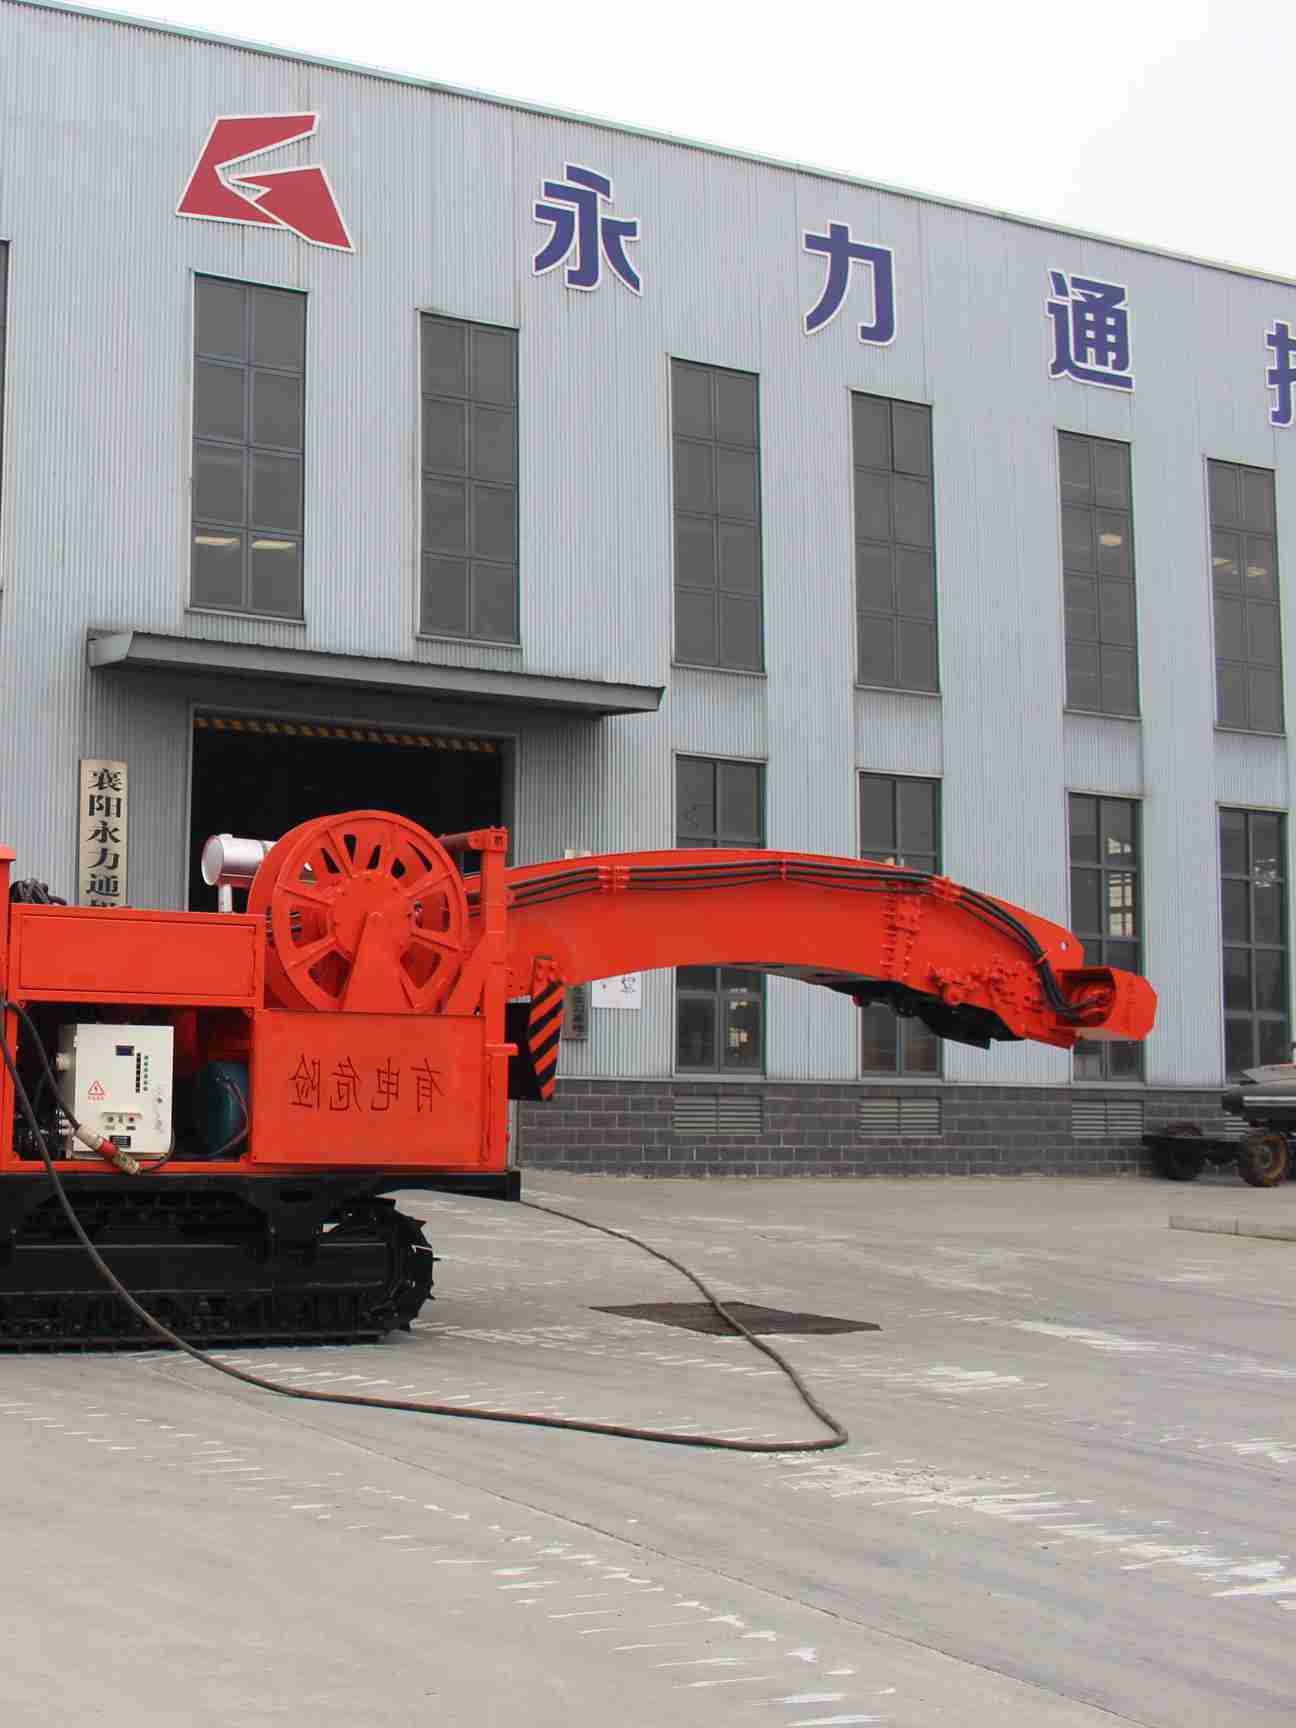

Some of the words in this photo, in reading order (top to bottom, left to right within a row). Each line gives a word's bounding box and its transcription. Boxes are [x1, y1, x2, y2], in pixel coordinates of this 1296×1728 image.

[86, 768, 122, 906] 襄阳永力通
